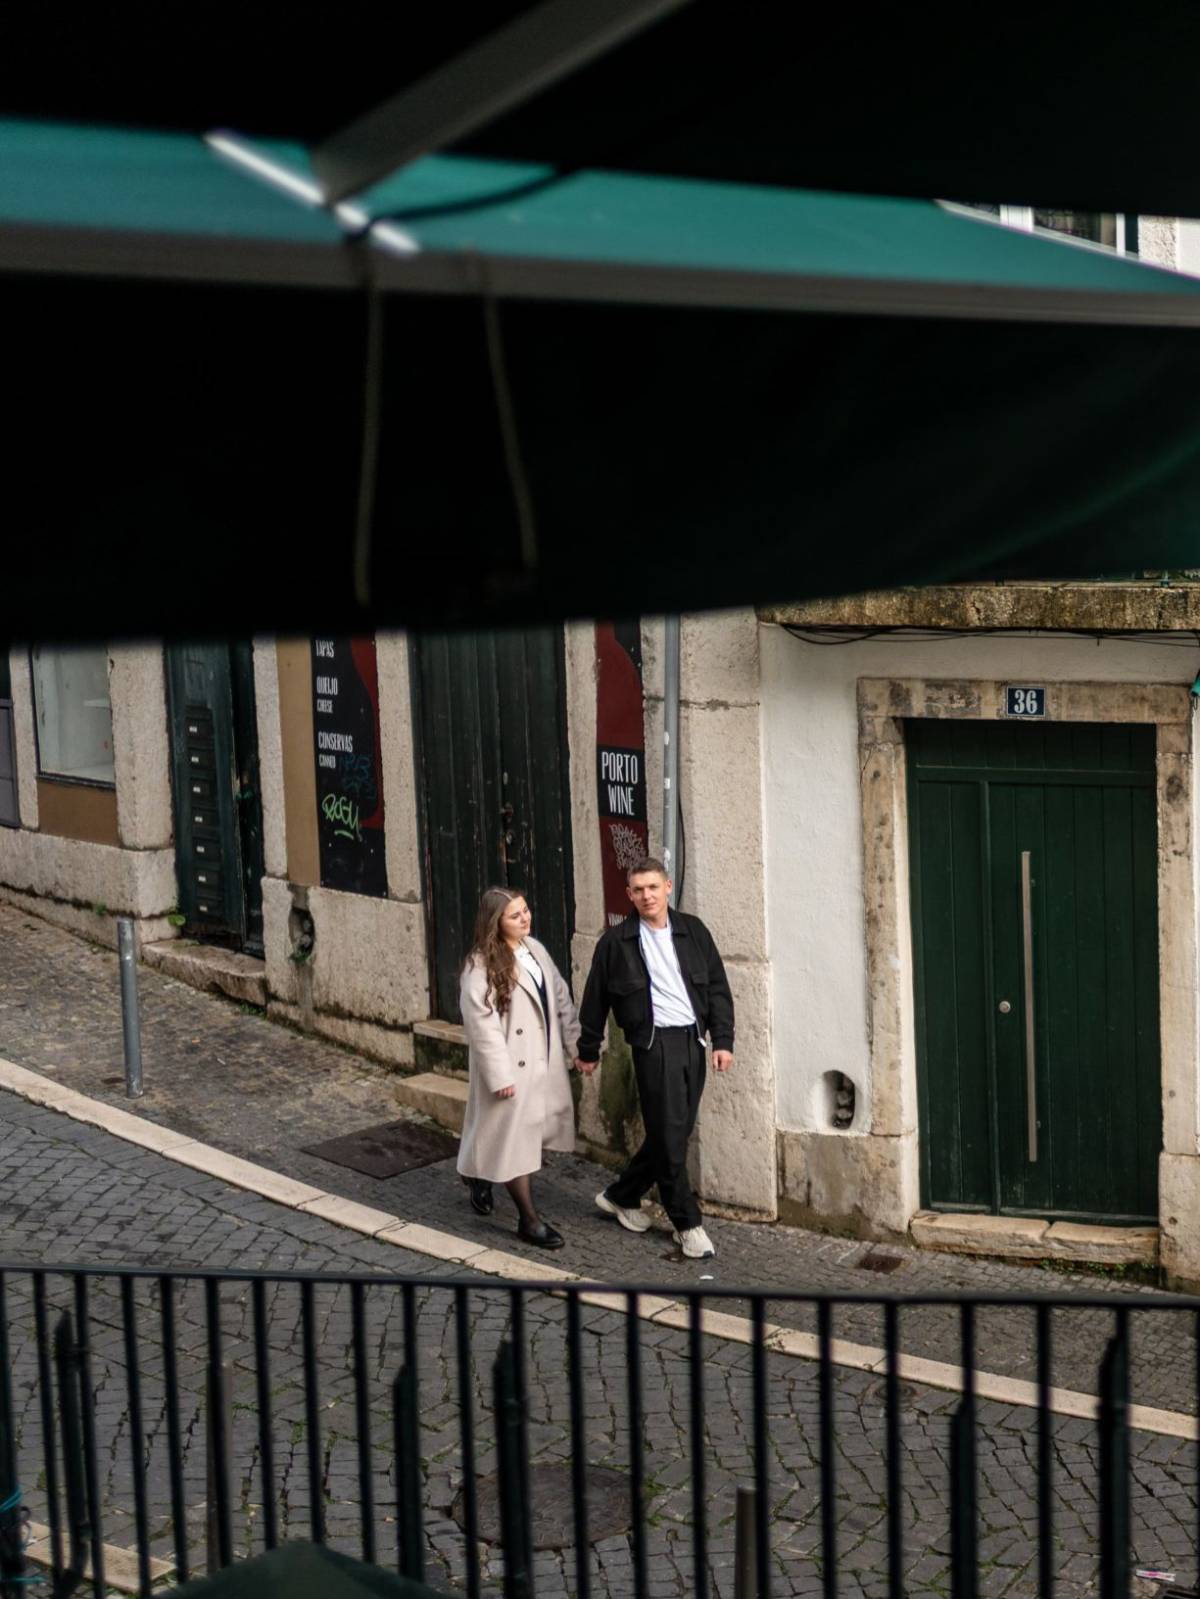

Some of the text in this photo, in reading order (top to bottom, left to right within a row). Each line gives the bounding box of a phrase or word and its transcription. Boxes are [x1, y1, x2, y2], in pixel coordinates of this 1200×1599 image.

[316, 676, 338, 695] QUEIJO
[1014, 689, 1037, 714] 36
[318, 731, 353, 753] CONSERVAS
[602, 751, 638, 785] PORTO
[608, 784, 635, 816] WINE
